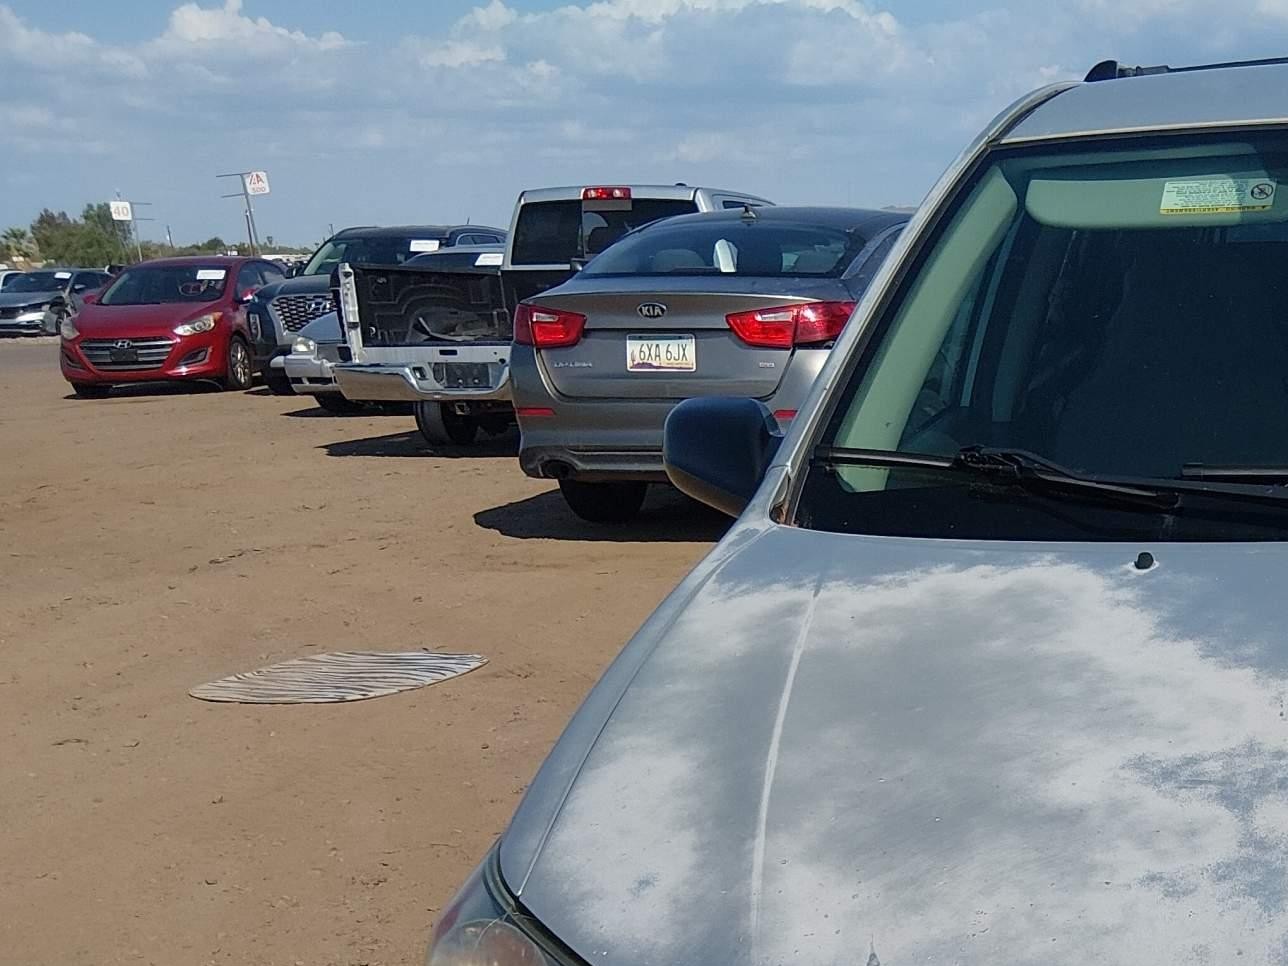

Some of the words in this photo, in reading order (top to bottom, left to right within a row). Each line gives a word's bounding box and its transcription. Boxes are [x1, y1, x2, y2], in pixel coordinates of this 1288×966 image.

[641, 306, 663, 316] KIA
[639, 343, 661, 362] 6XA
[666, 343, 689, 362] 6JX
